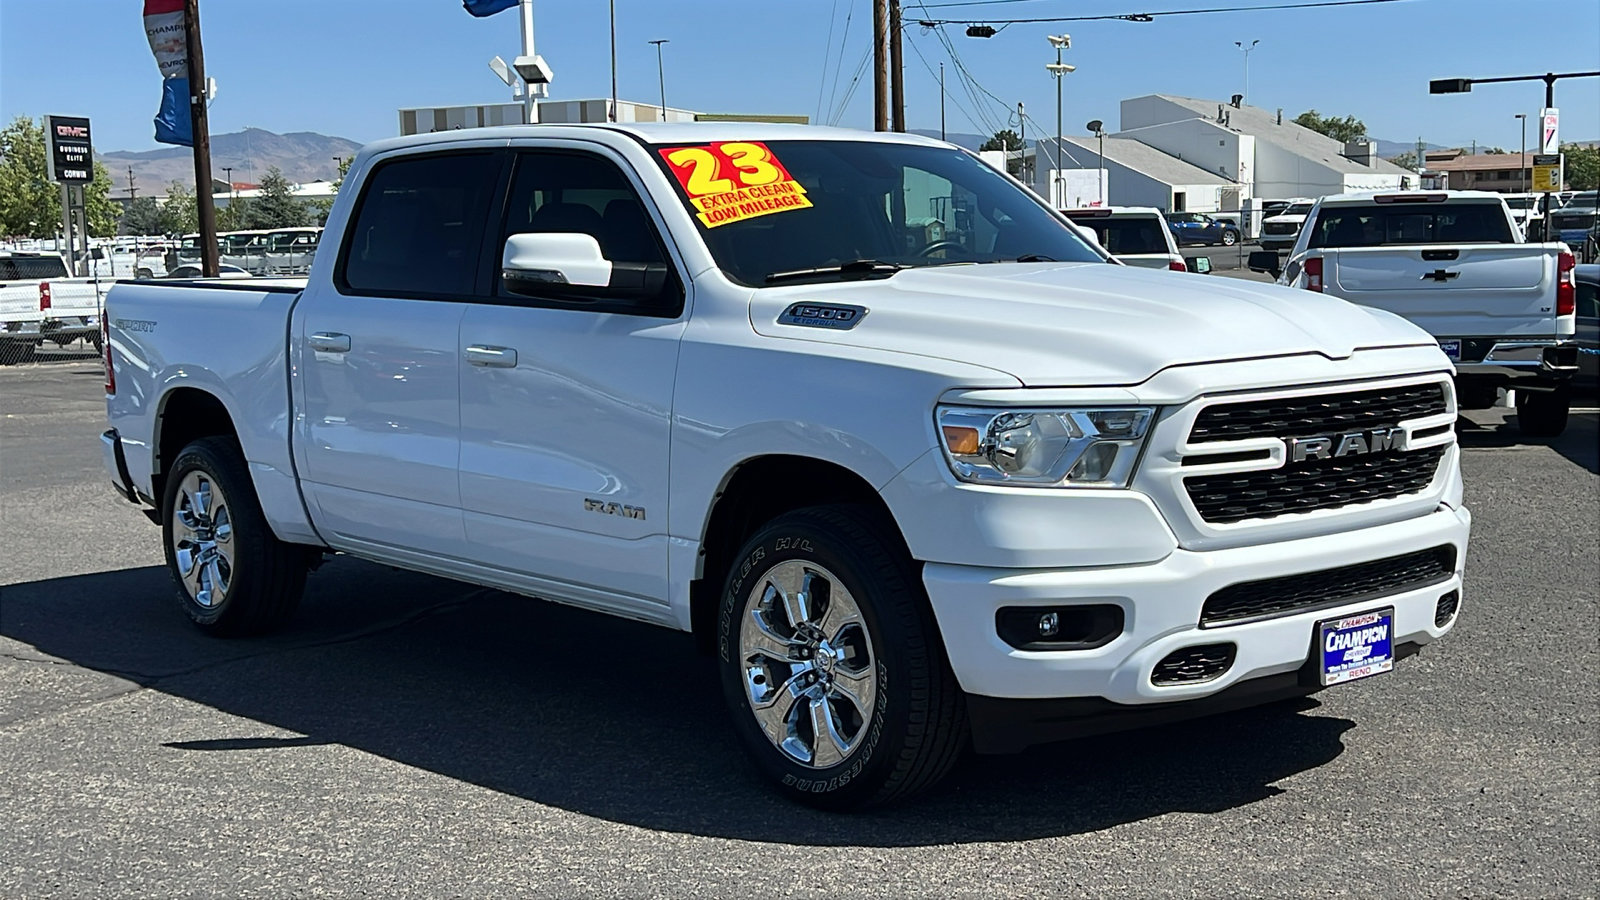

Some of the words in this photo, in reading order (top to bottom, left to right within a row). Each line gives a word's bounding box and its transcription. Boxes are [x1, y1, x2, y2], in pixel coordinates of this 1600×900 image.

[57, 125, 88, 137] GMC
[60, 145, 88, 154] BUSINESS
[66, 154, 83, 162] ELITE
[668, 142, 784, 195] 23
[700, 191, 748, 210] EXTRA
[750, 183, 795, 199] CLEAN
[705, 207, 740, 224] LOW
[741, 195, 804, 216] MILEAGE
[792, 305, 854, 320] 1500
[116, 319, 157, 333] SPORT
[1292, 426, 1407, 463] RAM
[584, 498, 646, 520] RAM
[775, 537, 814, 553] H/L
[1341, 615, 1376, 629] CHAMPION
[1325, 624, 1388, 653] CHAMPION
[1349, 667, 1371, 678] RENO
